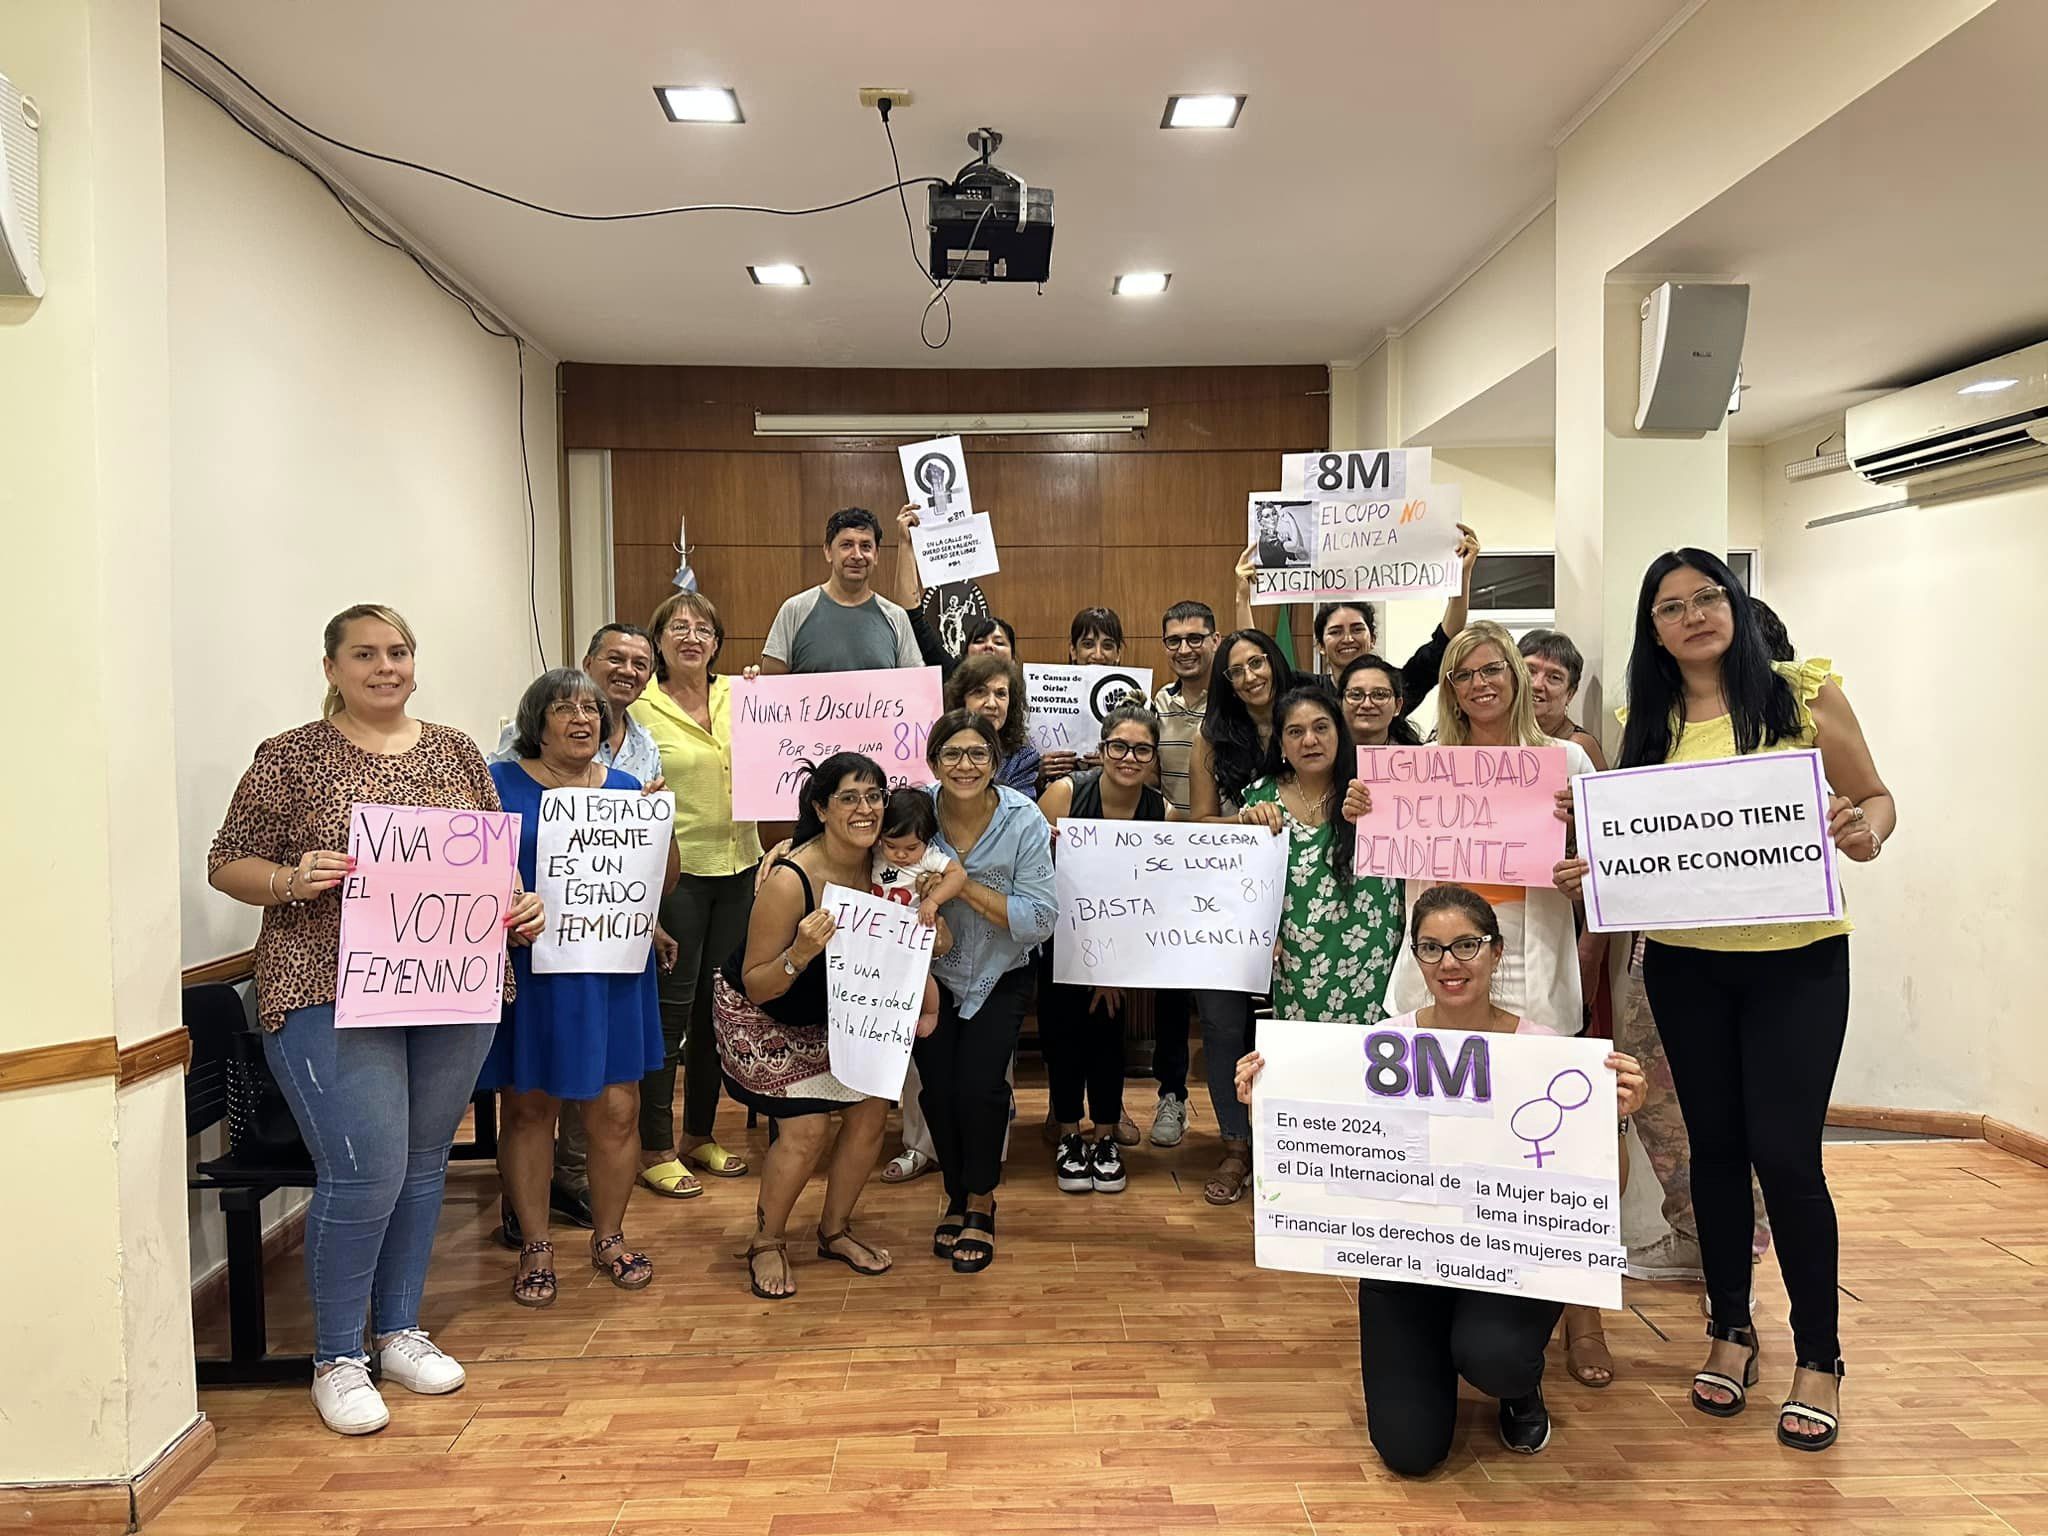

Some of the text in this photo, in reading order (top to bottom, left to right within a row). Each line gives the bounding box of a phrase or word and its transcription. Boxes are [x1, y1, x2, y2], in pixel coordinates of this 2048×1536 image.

[1317, 452, 1391, 491] 8M
[1321, 499, 1426, 526] EL CUPO NO
[944, 536, 962, 544] CALLE
[1322, 528, 1399, 552] ALCANZA
[1256, 568, 1347, 594] EXIGIMOS
[1029, 673, 1040, 681] Te
[1042, 673, 1071, 681] Cansas
[740, 692, 905, 724] NUNCA TE DISCULPES
[1029, 706, 1080, 715] DE VIVIRLO
[1030, 695, 1079, 704] NOSOTRAS
[778, 738, 883, 757] POR SER UNA
[1362, 746, 1541, 788] IGUALDAD
[542, 794, 671, 823] UN ESTADO
[1393, 793, 1498, 831] DEUDA
[1602, 803, 1806, 837] EL CUIDADO TIENE
[442, 813, 516, 867] 8M
[567, 828, 653, 854] AUSENTE
[1067, 825, 1259, 848] 8M NO SE CELEBRA
[547, 855, 623, 879] ES UN
[1184, 853, 1243, 872] LUCHA!
[1599, 843, 1822, 877] VALOR ECONOMICO
[345, 875, 371, 900] EL
[565, 879, 647, 905] ESTADO
[1240, 877, 1276, 903] 8M
[390, 892, 499, 945] VOTO
[1070, 895, 1222, 931] ¡BASTA DE
[1080, 937, 1118, 968] 8M
[854, 964, 881, 979] UNA
[832, 983, 916, 1011] Necesidad
[1364, 1030, 1493, 1103] 8M
[1277, 1112, 1387, 1138] En este 2024,
[1277, 1138, 1407, 1161] conmemoramos
[1278, 1160, 1608, 1210] el Día Internacional de la Mujer bajo el
[1476, 1204, 1616, 1235] lema inspirador:
[1352, 1222, 1375, 1238] los
[1379, 1224, 1455, 1246] derechos
[1460, 1232, 1481, 1248] de
[1486, 1234, 1511, 1251] las
[1514, 1242, 1582, 1262] mujeres
[1588, 1252, 1627, 1269] para
[1336, 1250, 1403, 1268] acelerar
[1408, 1255, 1422, 1270] la
